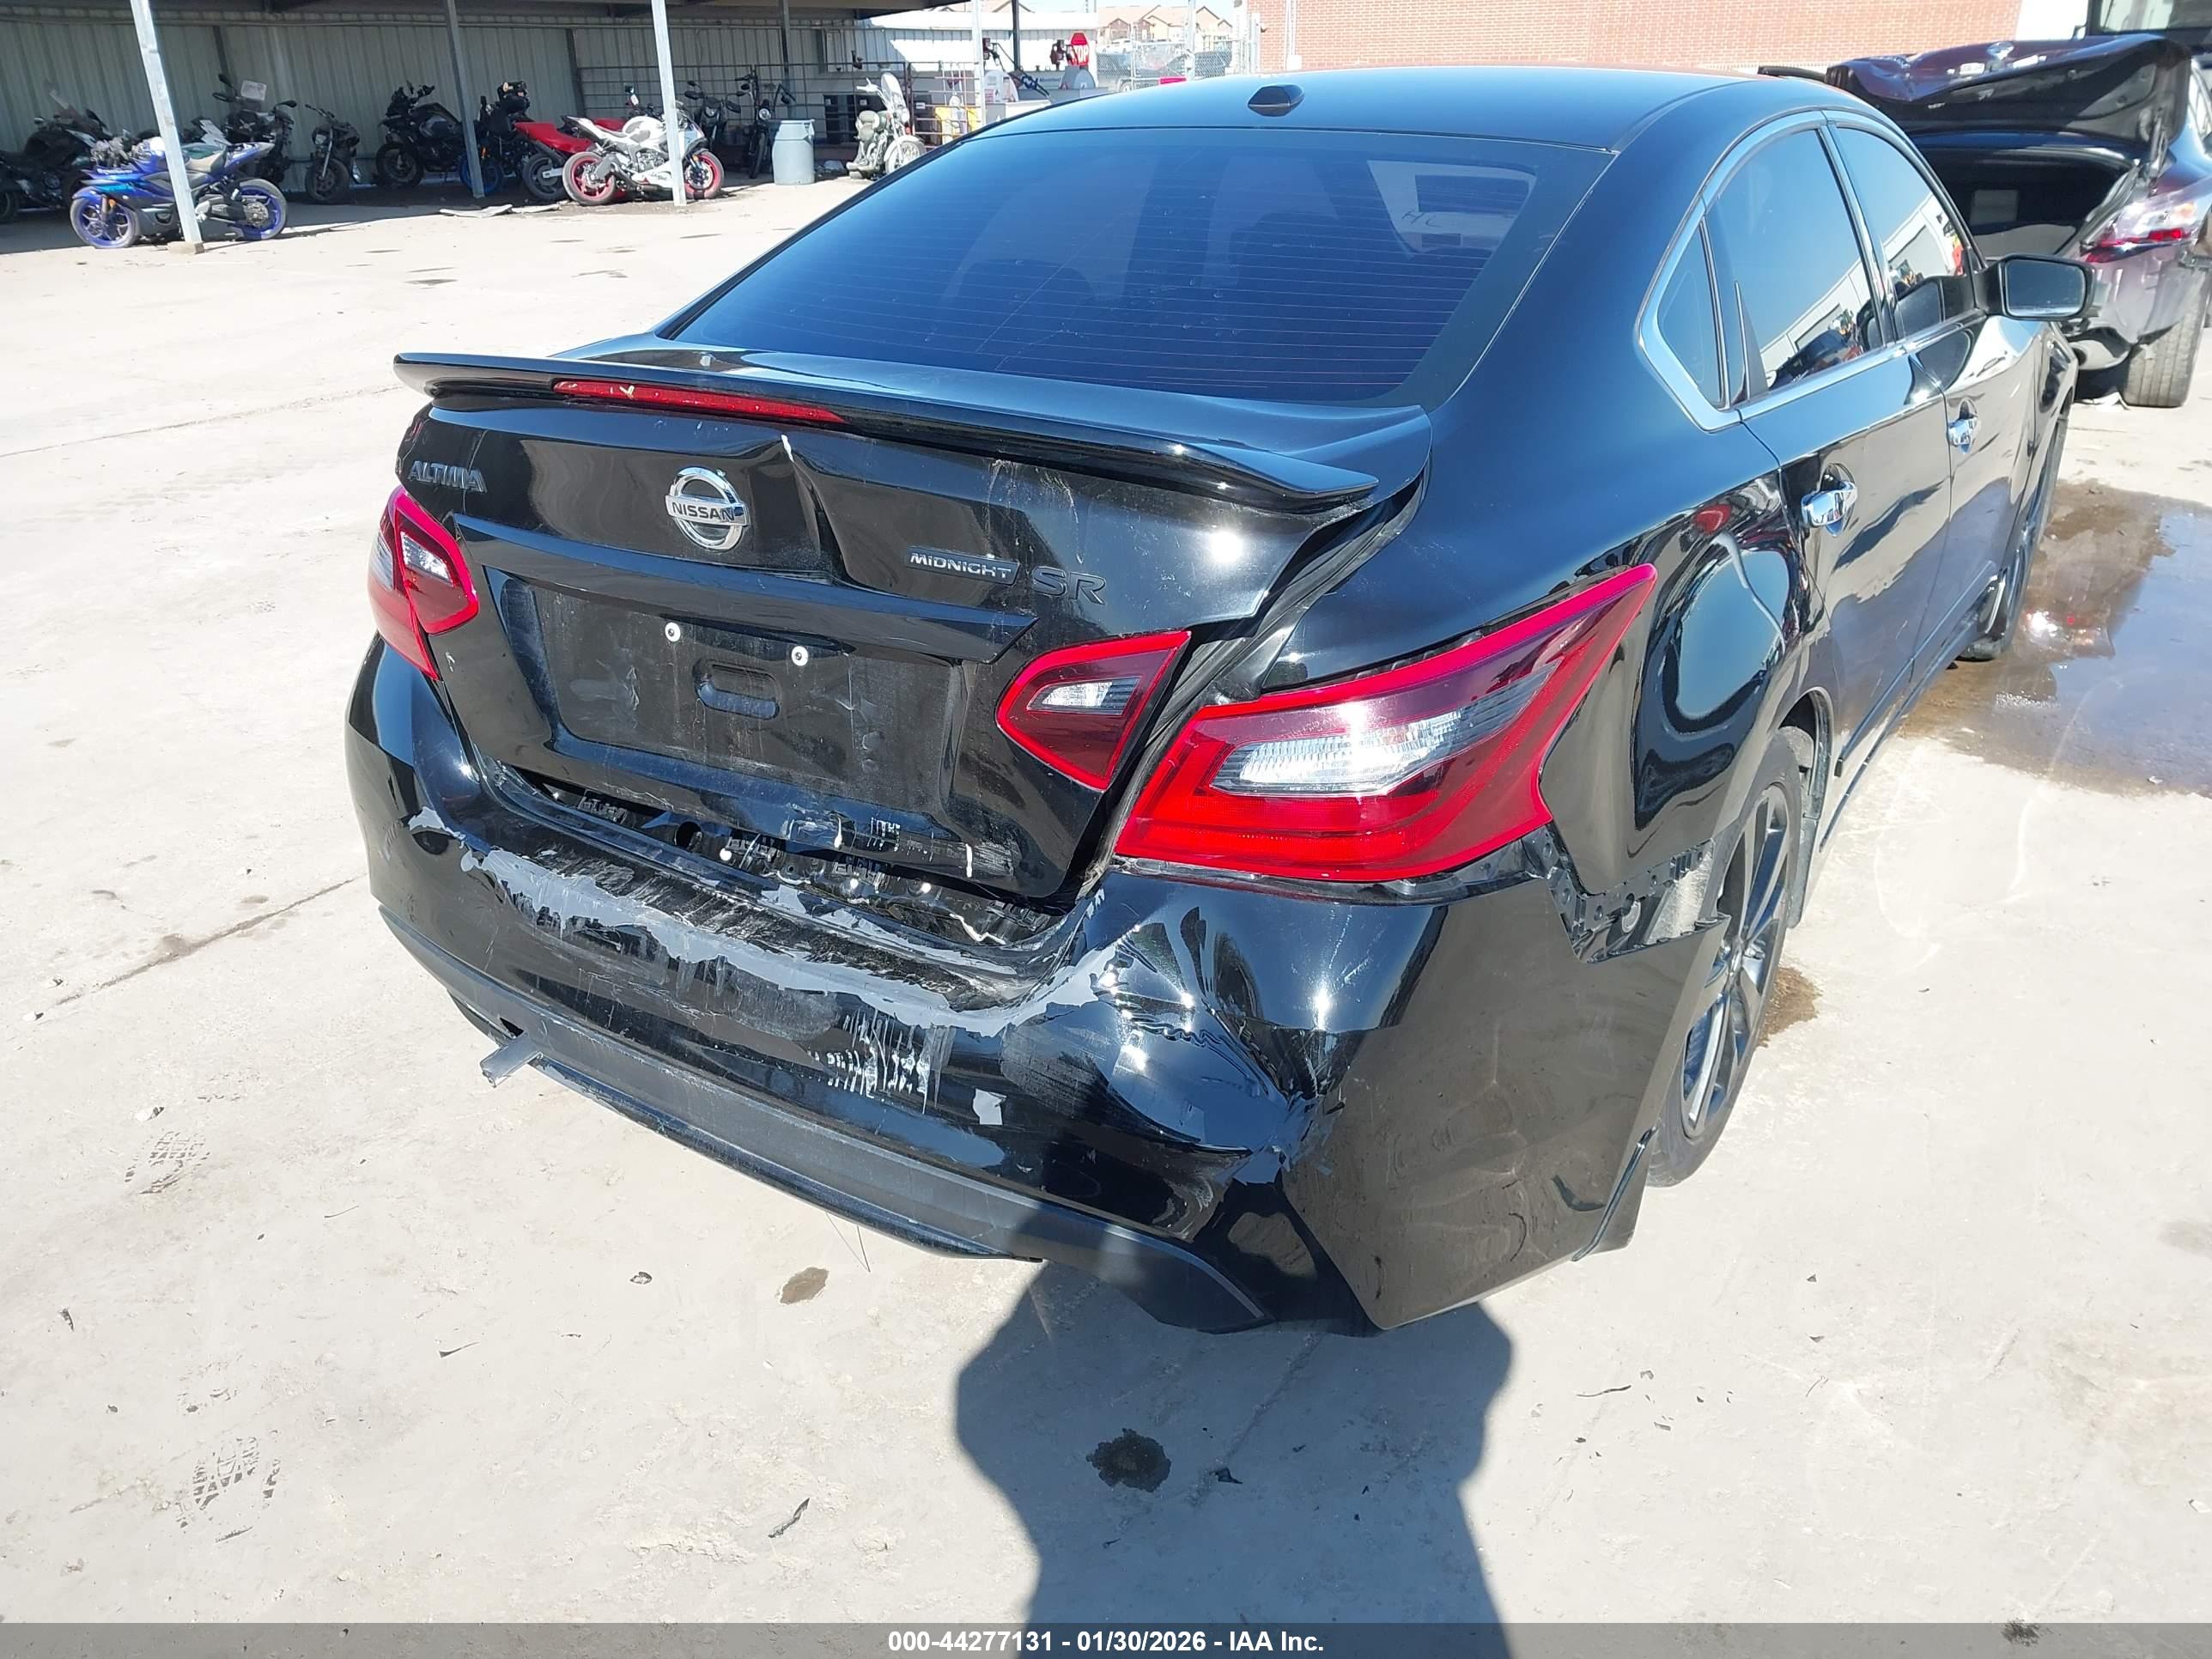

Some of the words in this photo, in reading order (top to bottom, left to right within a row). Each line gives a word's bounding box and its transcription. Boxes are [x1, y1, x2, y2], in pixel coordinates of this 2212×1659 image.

[408, 460, 488, 493] ALTIMA
[672, 501, 736, 521] NISSAN
[909, 552, 1012, 579] MIDNIGHT
[1030, 565, 1106, 605] SR
